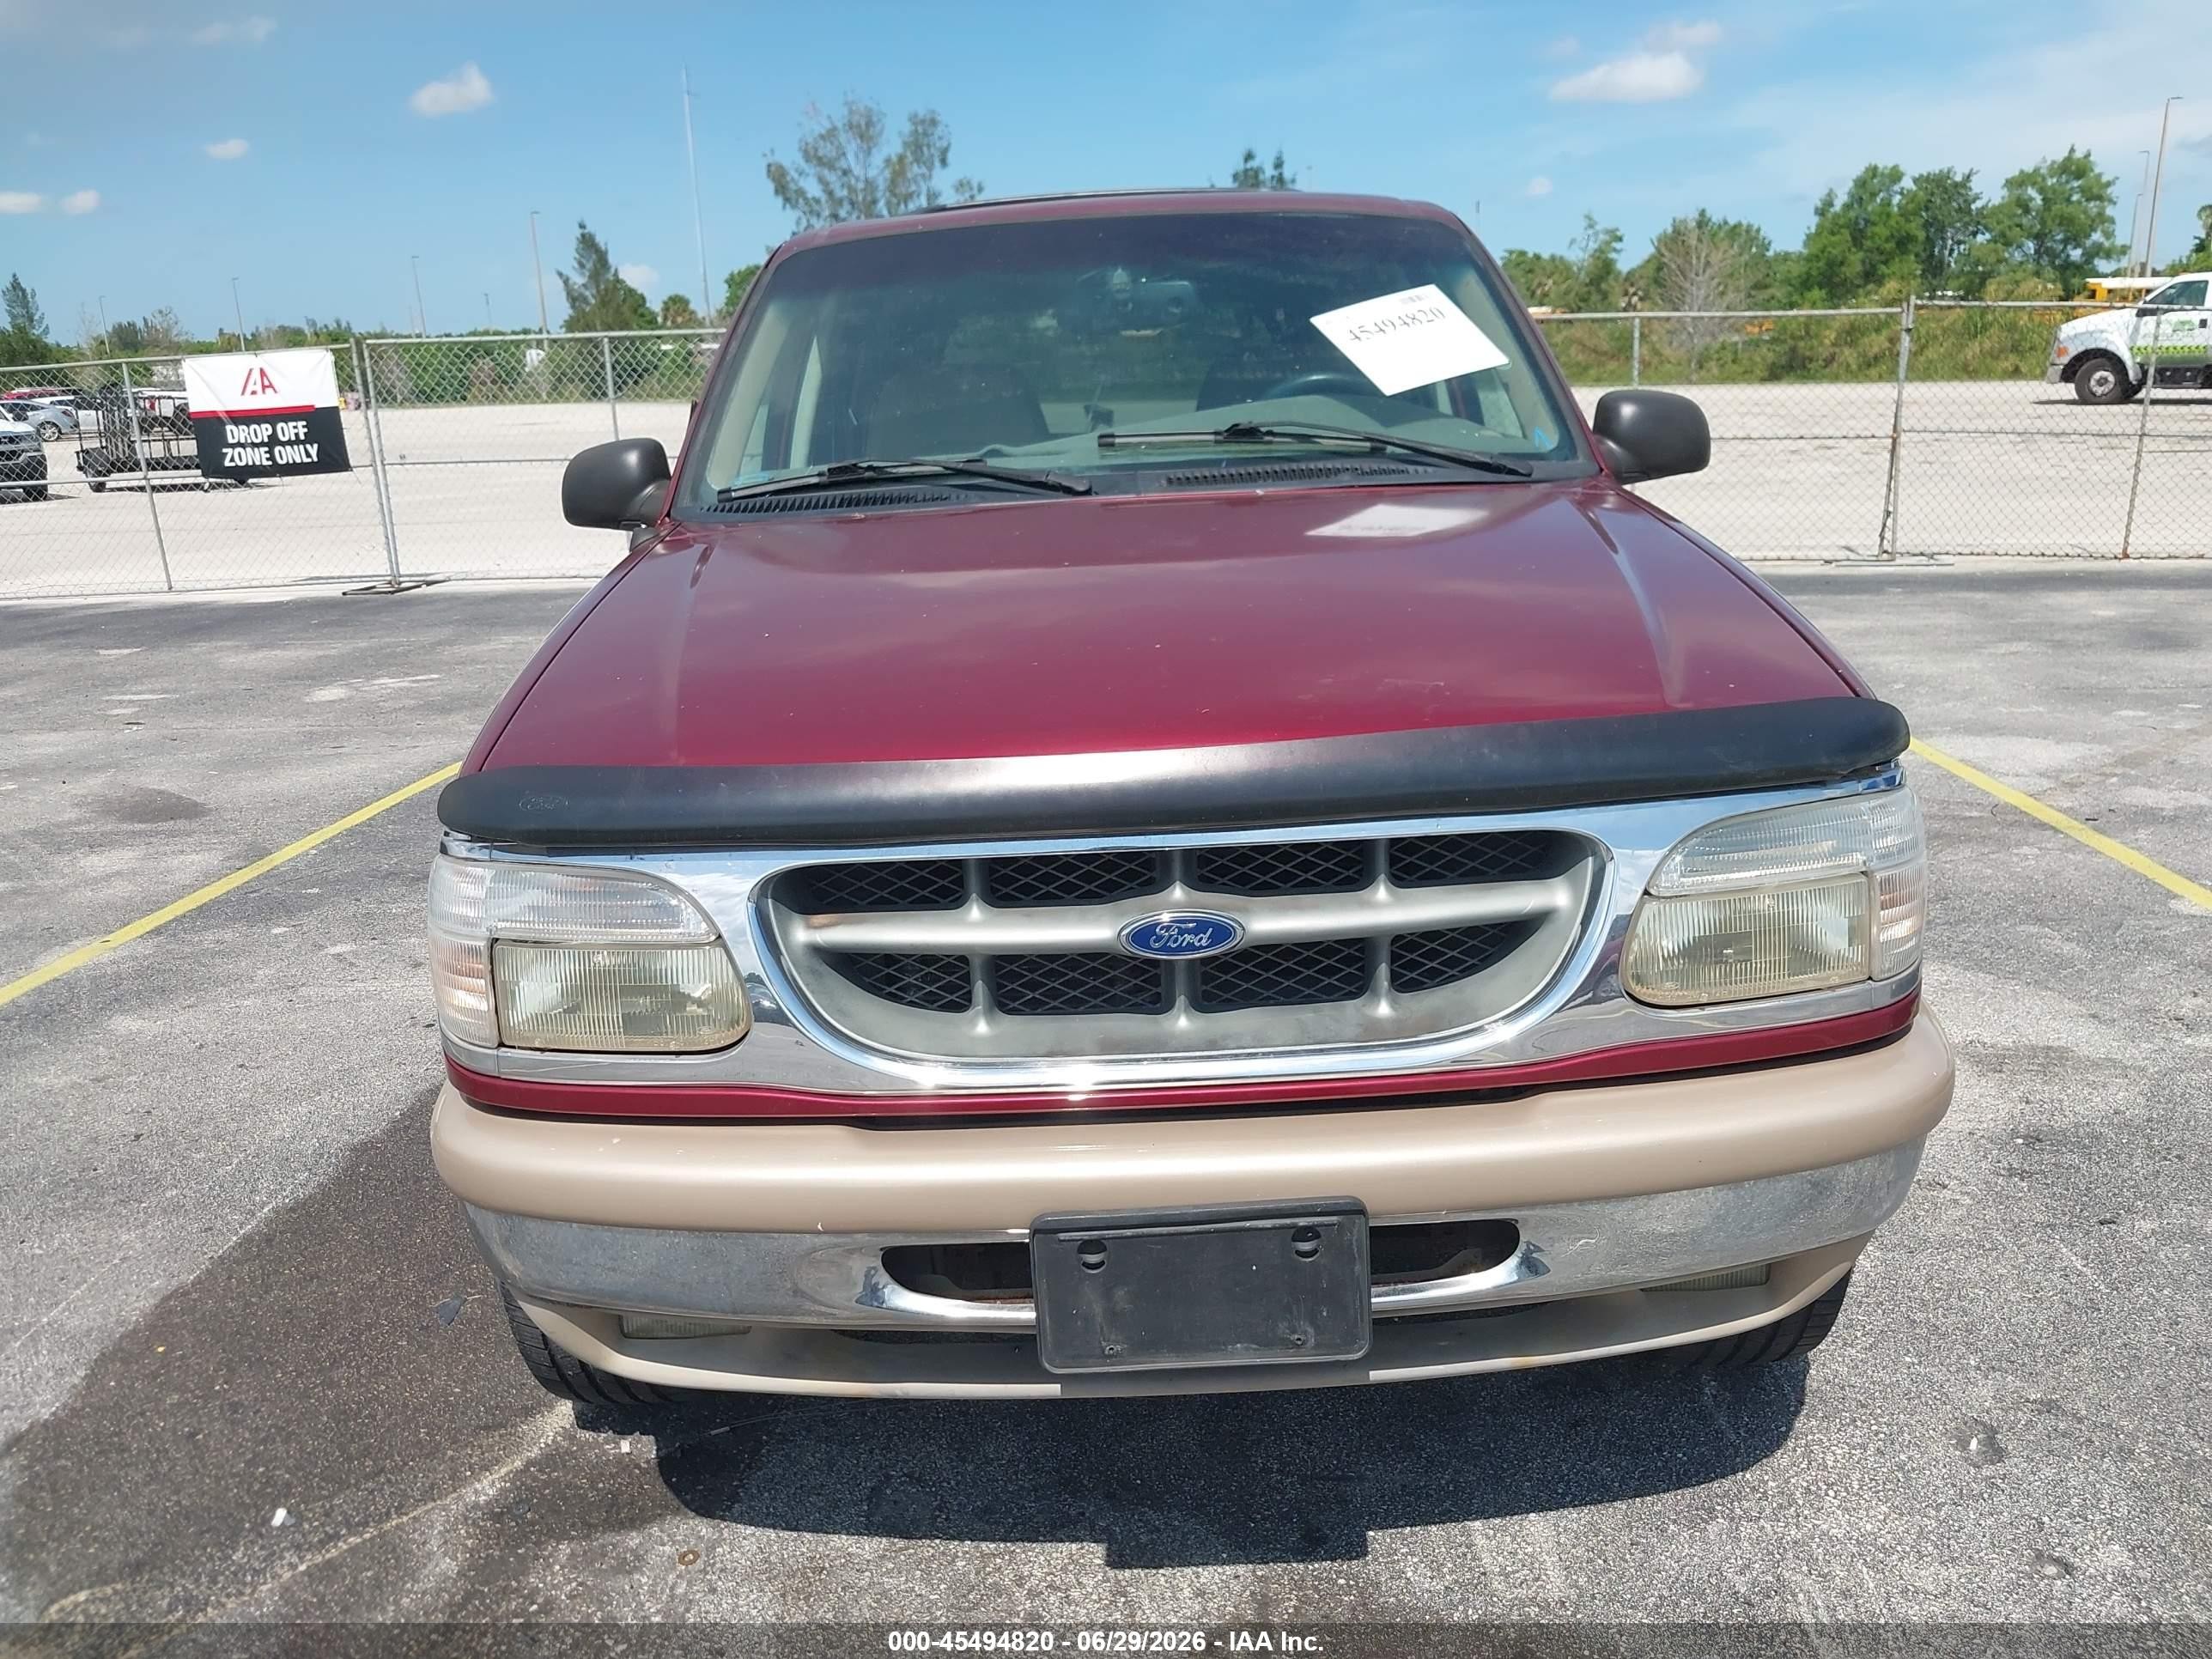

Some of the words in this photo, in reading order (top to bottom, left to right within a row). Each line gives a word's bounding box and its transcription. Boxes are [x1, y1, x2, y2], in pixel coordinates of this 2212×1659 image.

[225, 423, 273, 444] DROP
[276, 421, 308, 441] OFF
[222, 447, 272, 467] ZONE
[274, 443, 319, 465] ONLY
[1149, 921, 1213, 949] Ford
